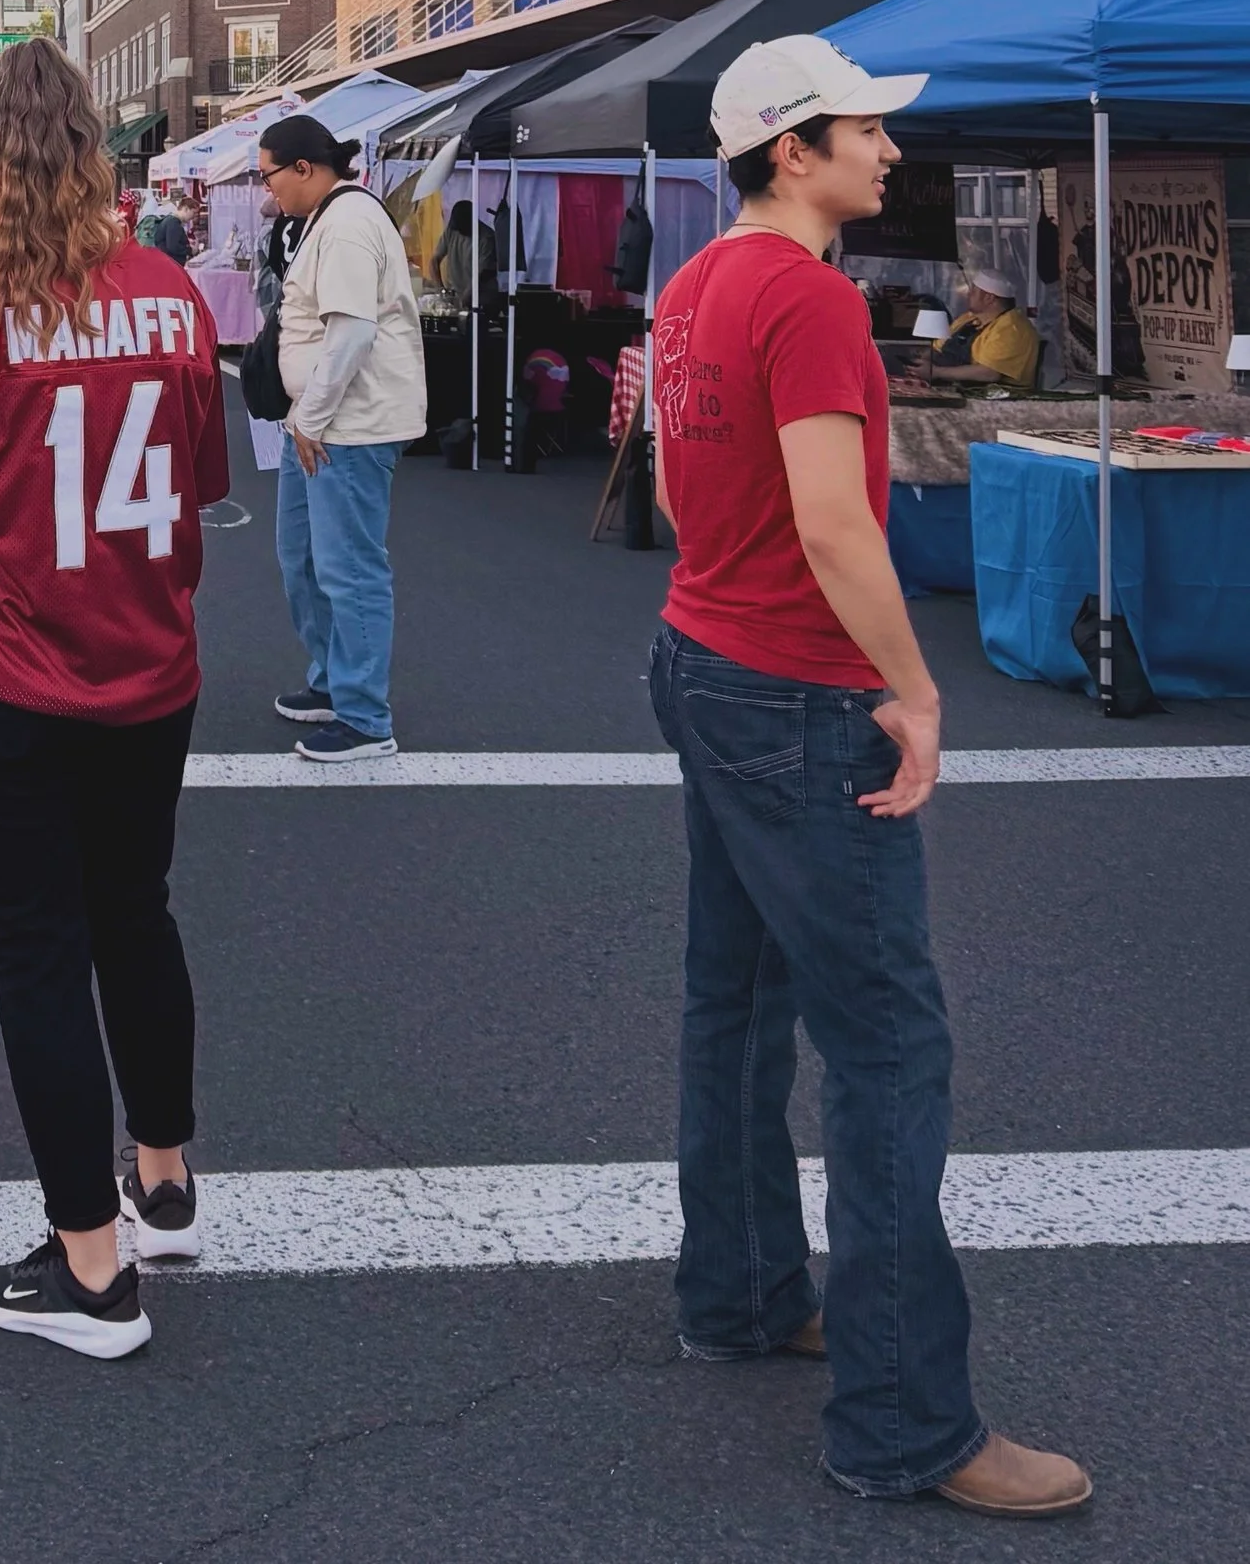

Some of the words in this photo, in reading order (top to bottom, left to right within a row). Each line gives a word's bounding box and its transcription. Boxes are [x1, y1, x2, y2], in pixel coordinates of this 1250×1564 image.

[1123, 199, 1219, 260] DEDMAN'S
[1135, 252, 1215, 310] DEPOT
[1142, 314, 1177, 341] POP-UP
[1179, 318, 1217, 346] BAKERY
[698, 388, 721, 417] to
[44, 381, 182, 571] 14
